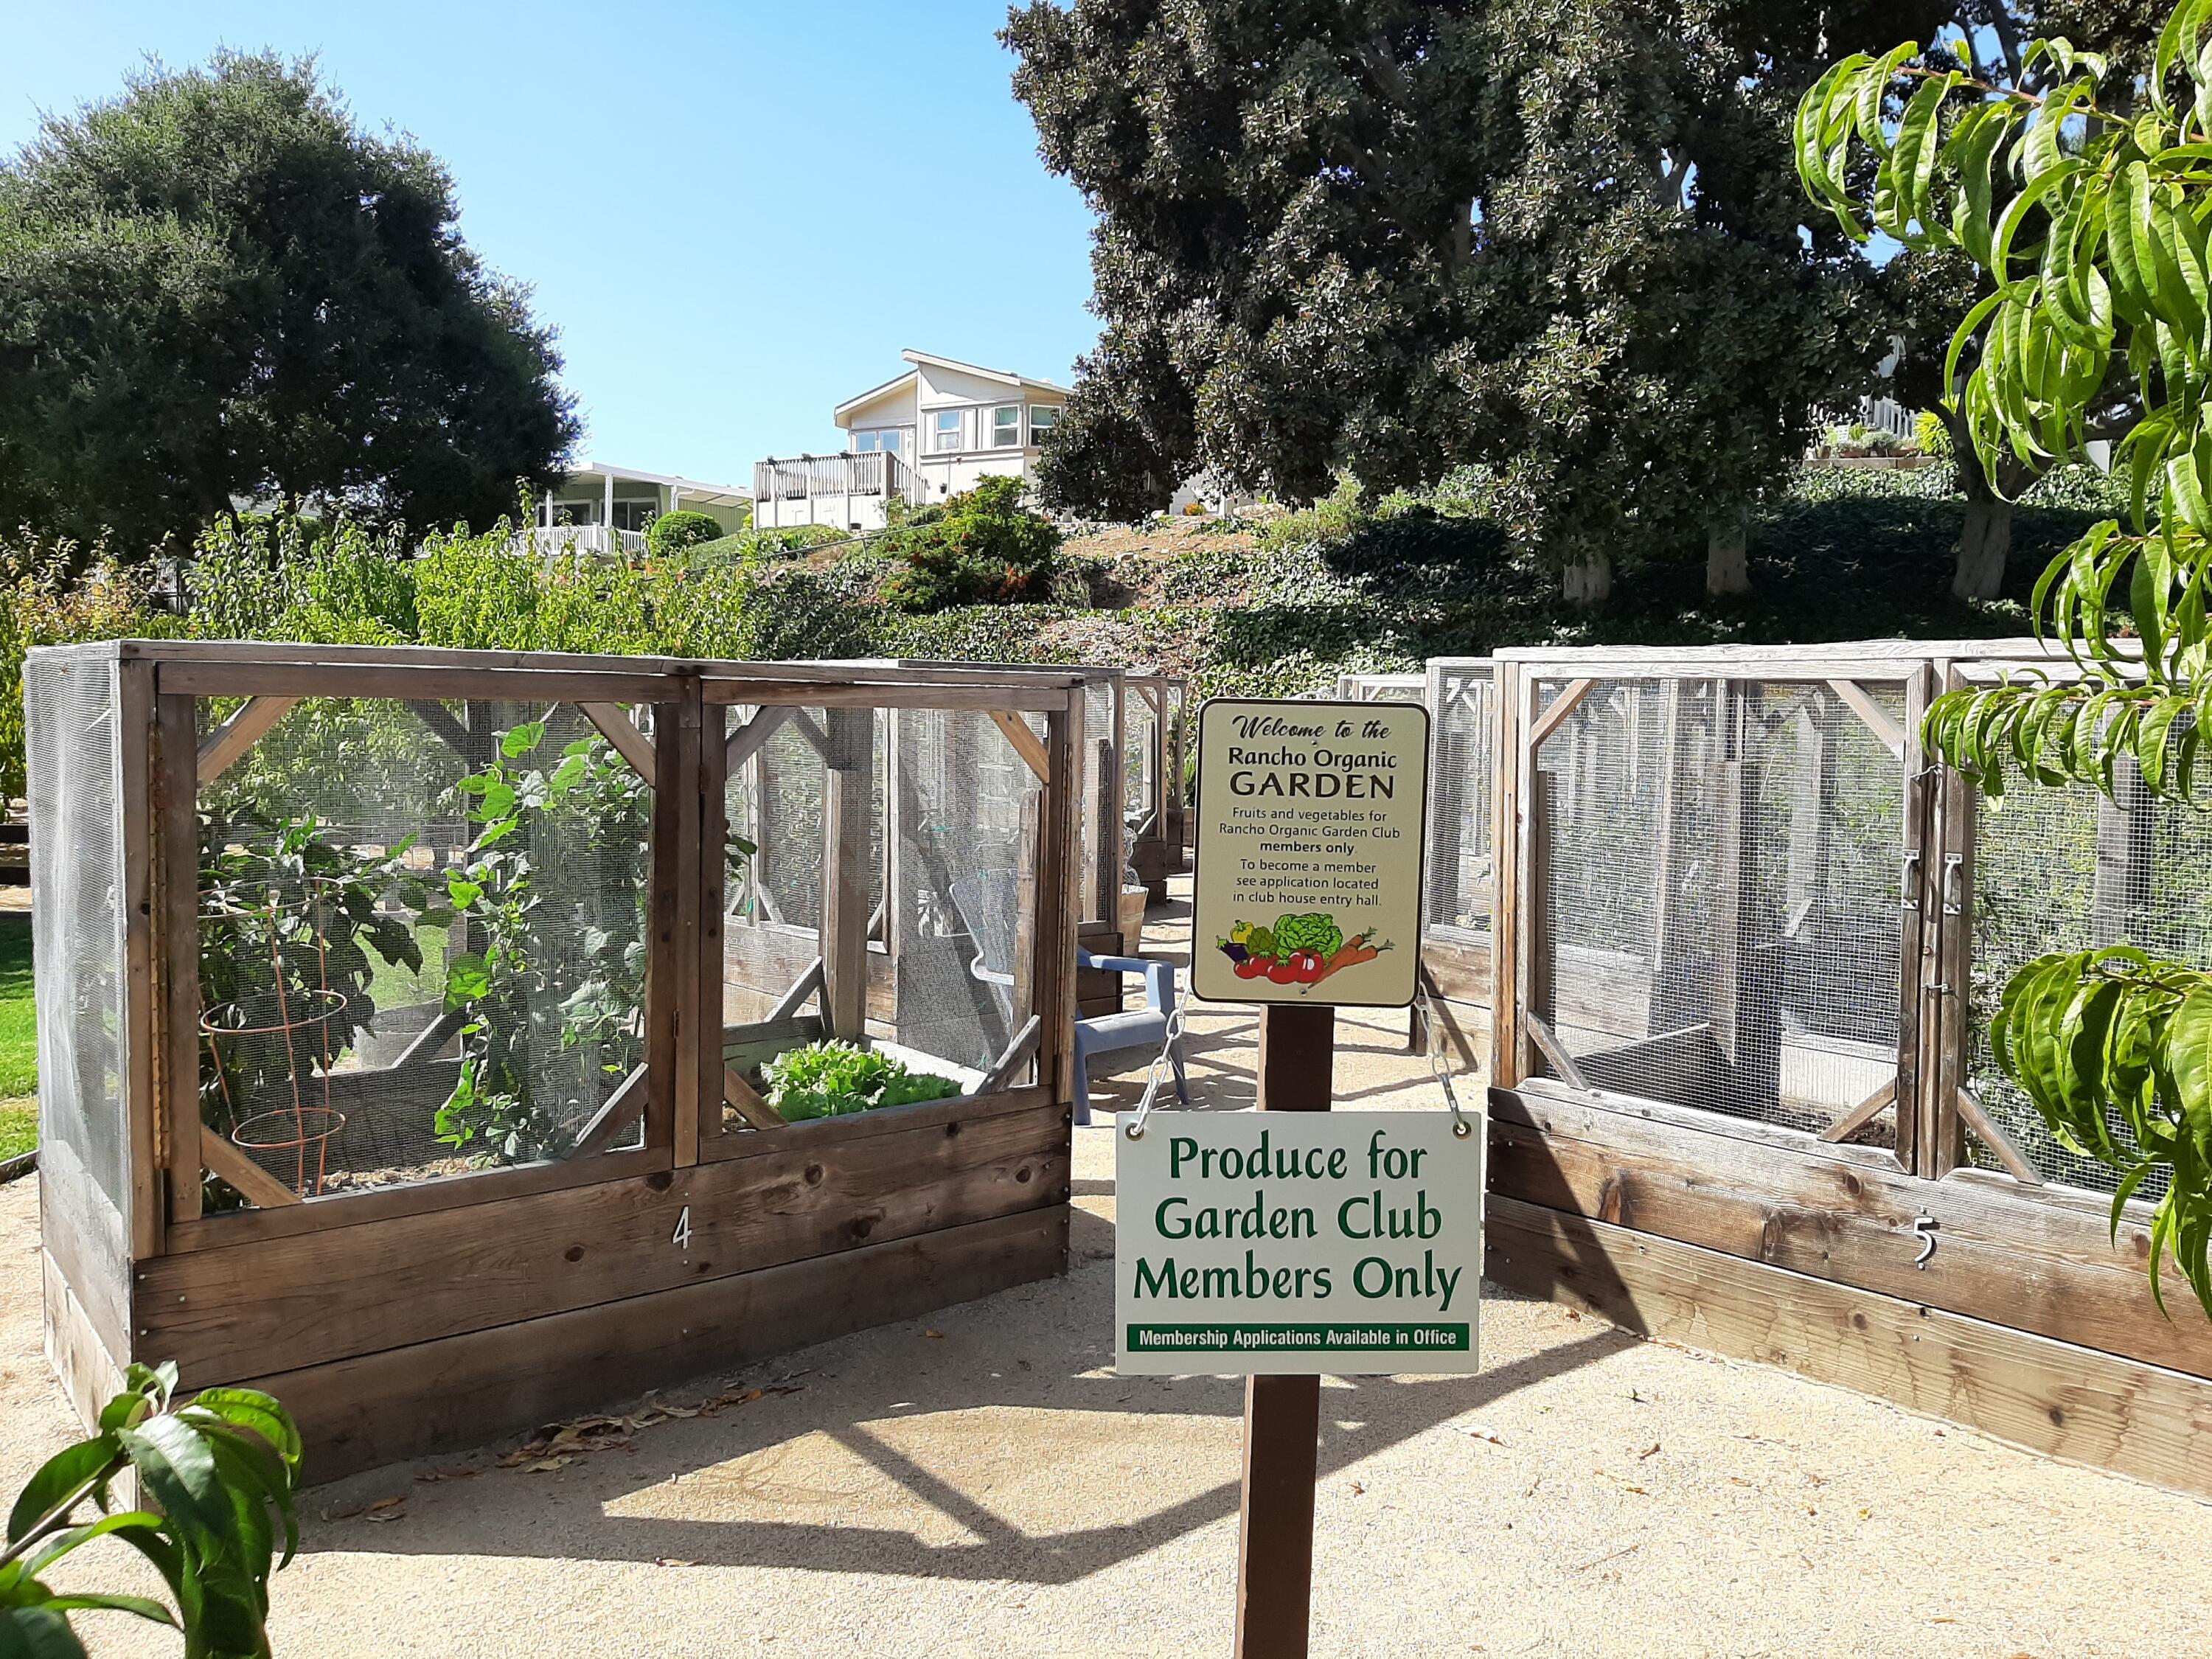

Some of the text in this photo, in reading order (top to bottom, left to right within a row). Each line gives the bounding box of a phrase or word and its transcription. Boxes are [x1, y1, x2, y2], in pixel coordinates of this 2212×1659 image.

[1232, 715, 1392, 739] Welcome to the
[1228, 746, 1397, 772] Rancho Organic
[1230, 771, 1394, 799] GARDEN
[1233, 807, 1387, 822] Fruits and vegetables for
[1220, 823, 1400, 838] Rancho Organic Garden Club
[1260, 841, 1321, 852] members
[1240, 859, 1376, 873] To become a member
[1237, 876, 1378, 889] see application located
[1233, 891, 1381, 908] in club house entry hall.
[1169, 1129, 1427, 1179] Produce for
[1155, 1189, 1442, 1239] Garden Club
[672, 1206, 692, 1250] 4
[1913, 1217, 1933, 1262] 5
[1133, 1249, 1462, 1312] Members Only
[1139, 1329, 1456, 1348] Membership Applications Available in Office
